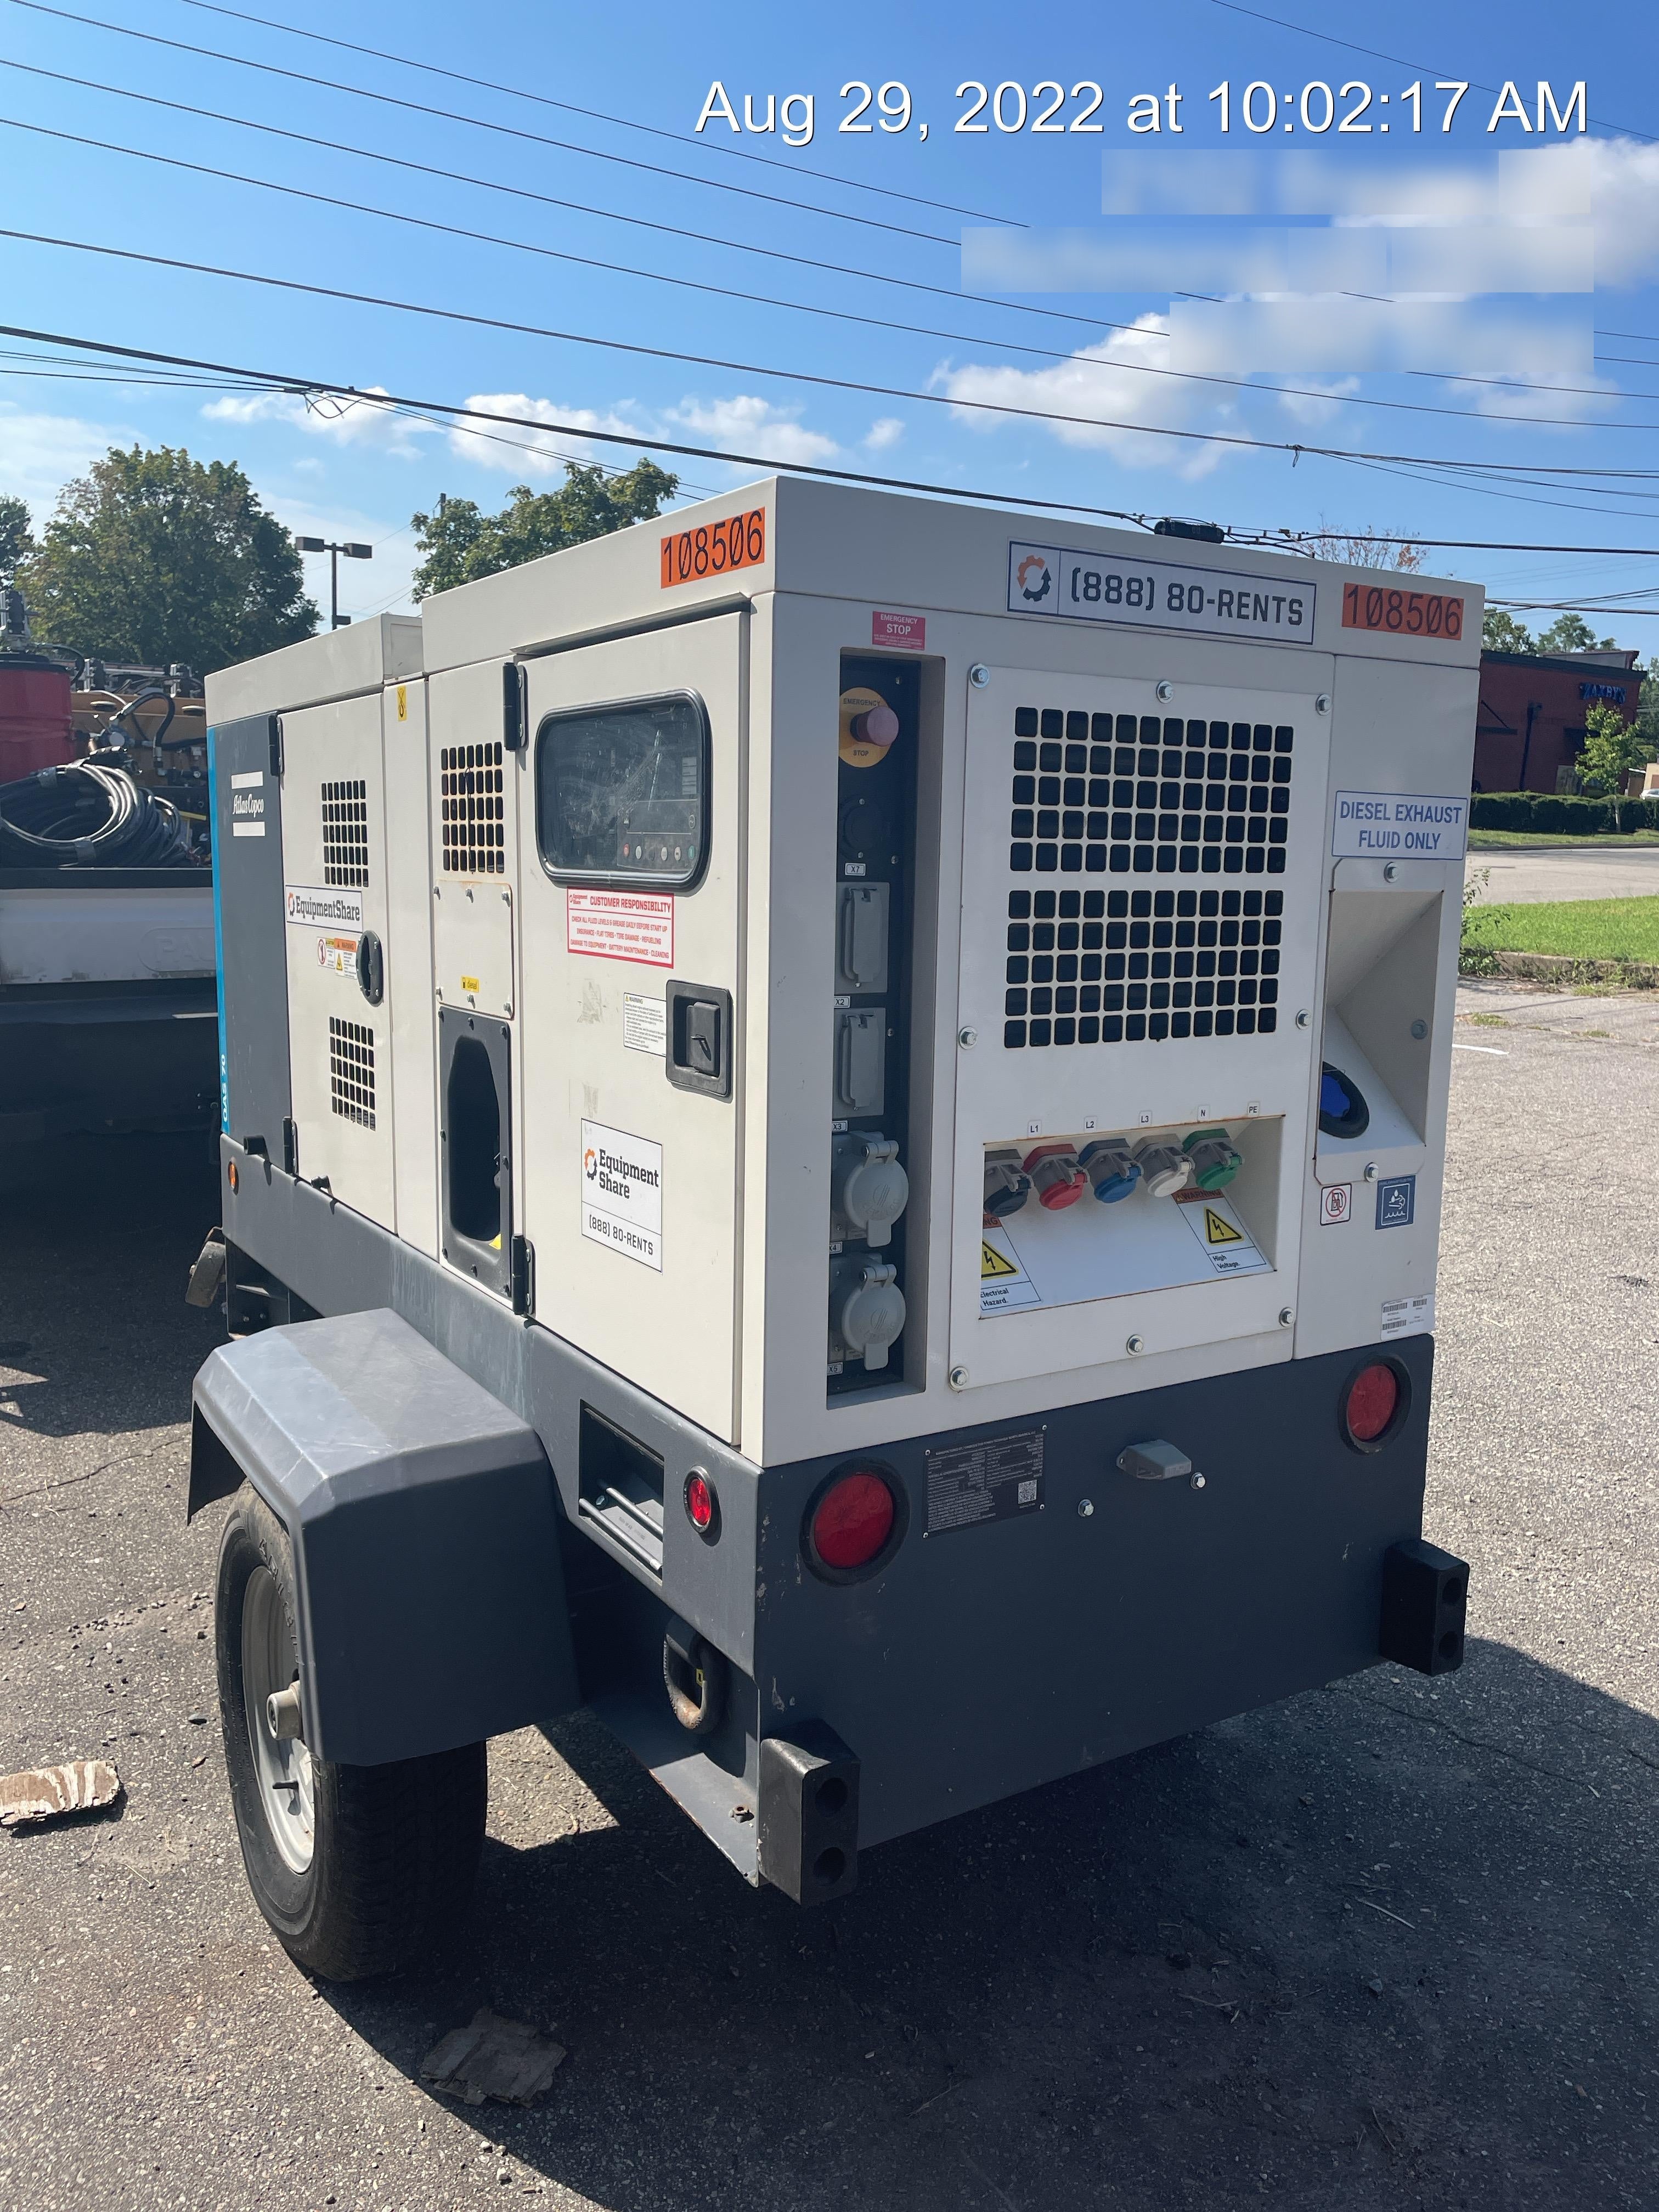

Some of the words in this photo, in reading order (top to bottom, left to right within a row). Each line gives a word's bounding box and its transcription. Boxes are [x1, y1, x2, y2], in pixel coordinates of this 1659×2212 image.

[664, 510, 763, 583] 108506
[1071, 567, 1155, 611] (888)
[1167, 583, 1304, 626] 80-RENTS
[880, 614, 918, 624] EMERGENCY
[1347, 585, 1462, 636] 108506
[887, 623, 911, 635] STOP
[843, 698, 881, 707] EMERGENCY
[1340, 801, 1391, 821] DIESEL
[1395, 804, 1462, 823] EXHAUST
[1358, 830, 1400, 849] FLUID
[1404, 832, 1441, 850] ONLY
[590, 896, 620, 907] CUSTOMER
[620, 898, 671, 913] RESPONSIBILITY
[608, 944, 623, 952] BATTERY
[623, 945, 648, 956] MAINTENANCE
[1249, 1105, 1258, 1113] PE
[1141, 1115, 1149, 1124] L3
[599, 1148, 659, 1188] Equipment
[599, 1171, 630, 1199] Share
[1181, 1189, 1222, 1200] WARNING
[589, 1214, 610, 1237] (888)
[613, 1226, 653, 1256] 80-RENTS
